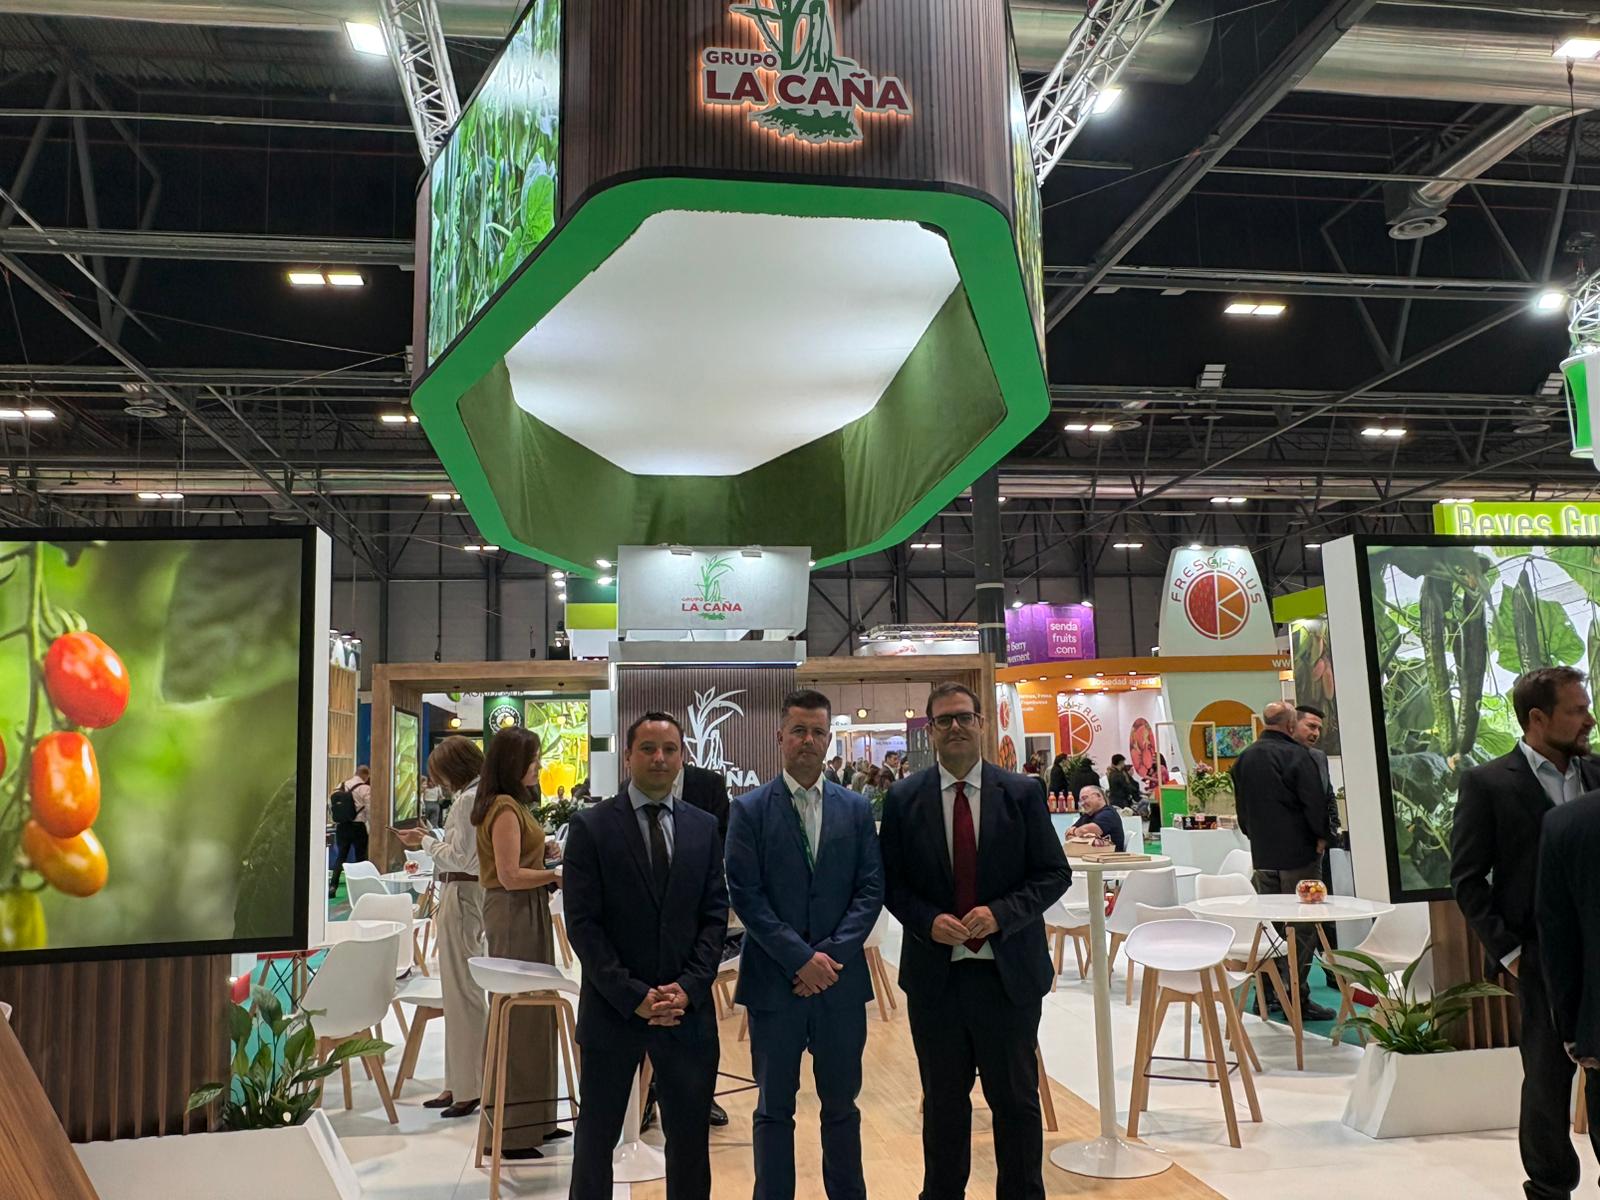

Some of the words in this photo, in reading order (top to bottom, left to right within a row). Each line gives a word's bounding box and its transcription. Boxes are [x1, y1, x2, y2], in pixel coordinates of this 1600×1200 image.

[706, 50, 777, 68] GRUPO
[706, 70, 765, 102] LA
[777, 72, 908, 110] CAÑA
[1456, 504, 1552, 536] Reyes
[681, 603, 699, 612] LA
[703, 601, 742, 612] CAÑA
[1050, 622, 1078, 632] senda
[1052, 633, 1077, 643] fruits
[1055, 646, 1077, 655] .com
